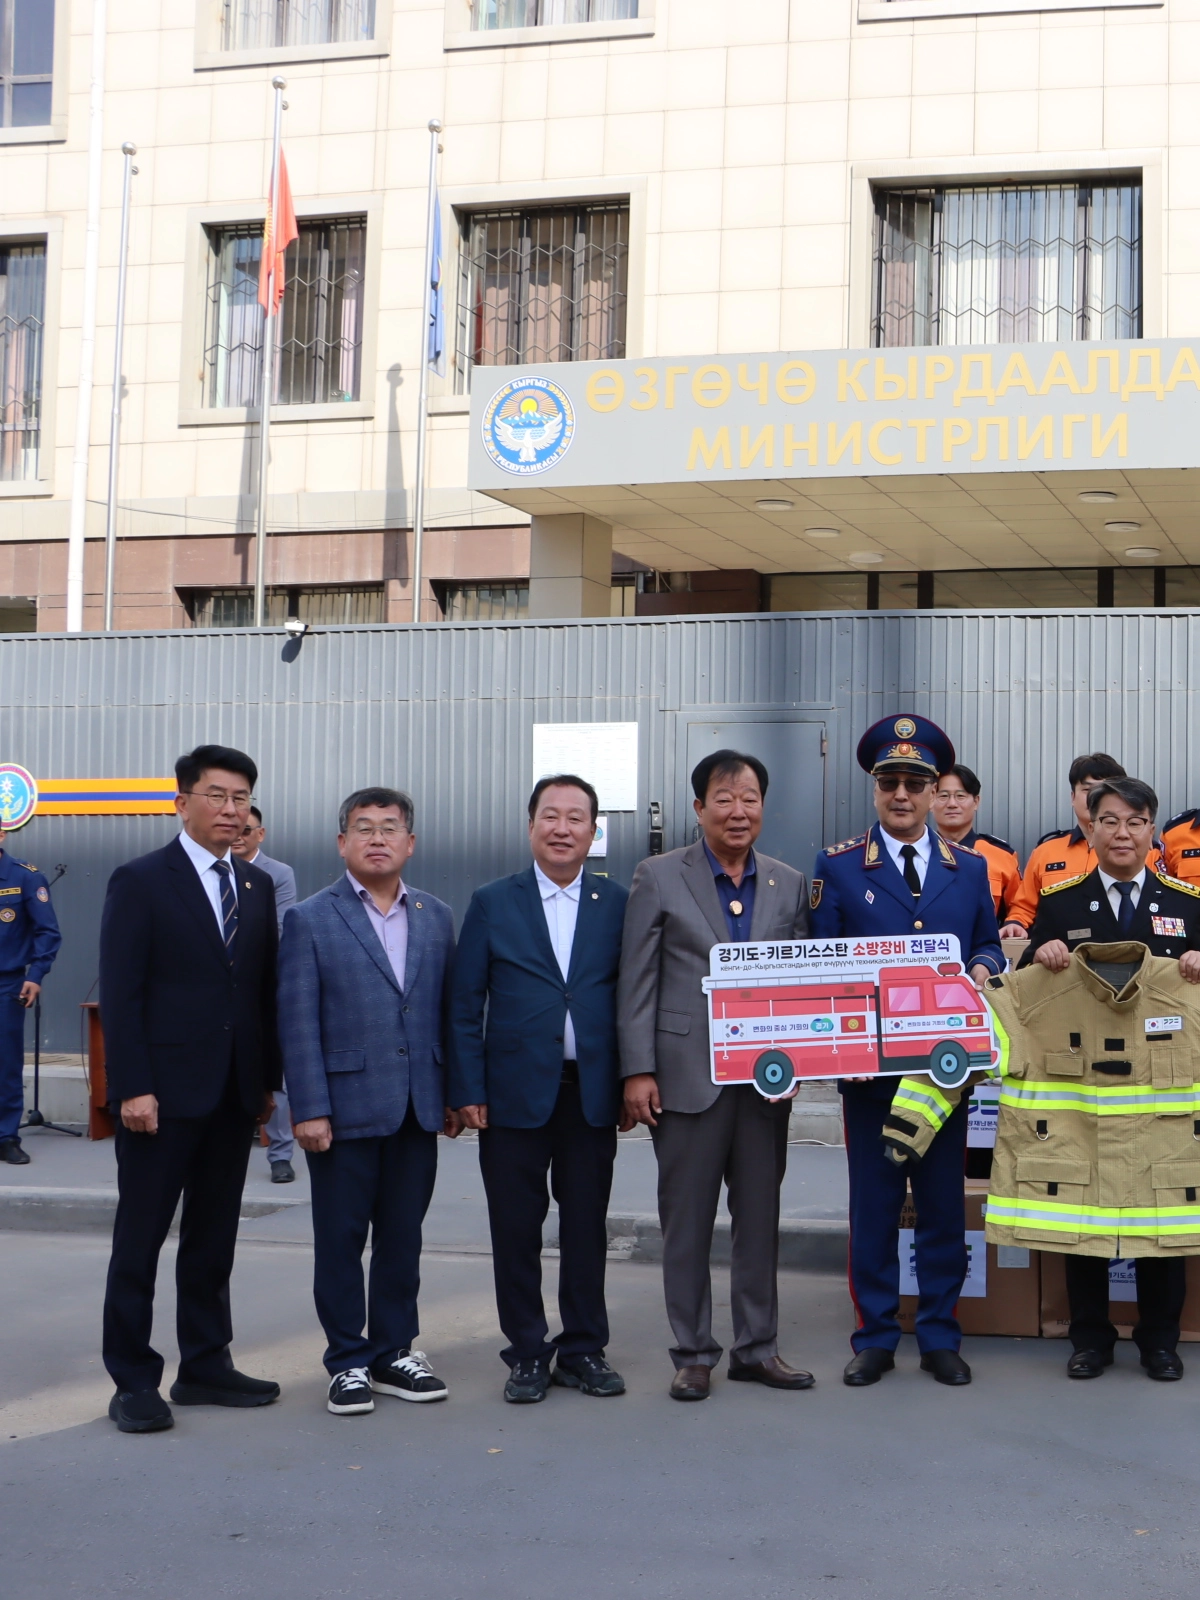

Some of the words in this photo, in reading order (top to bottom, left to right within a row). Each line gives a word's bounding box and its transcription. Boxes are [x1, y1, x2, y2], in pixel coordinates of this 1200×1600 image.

[512, 378, 548, 389] КЫРГЫЗ
[585, 359, 816, 413] ӨЗГӨЧӨ
[686, 413, 1128, 470] МИНИСТРЛИГИ
[496, 451, 560, 473] РЕСПУБЛИКАСЫ
[718, 943, 848, 963] 경기도-키르기스스탄
[853, 940, 906, 957] 소방장비
[910, 938, 950, 954] 전달식
[855, 957, 896, 966] техникасын
[896, 956, 930, 965] тапшыруу
[752, 1025, 772, 1033] 변화의
[789, 1023, 809, 1031] 기회의
[815, 1022, 829, 1030] 경기
